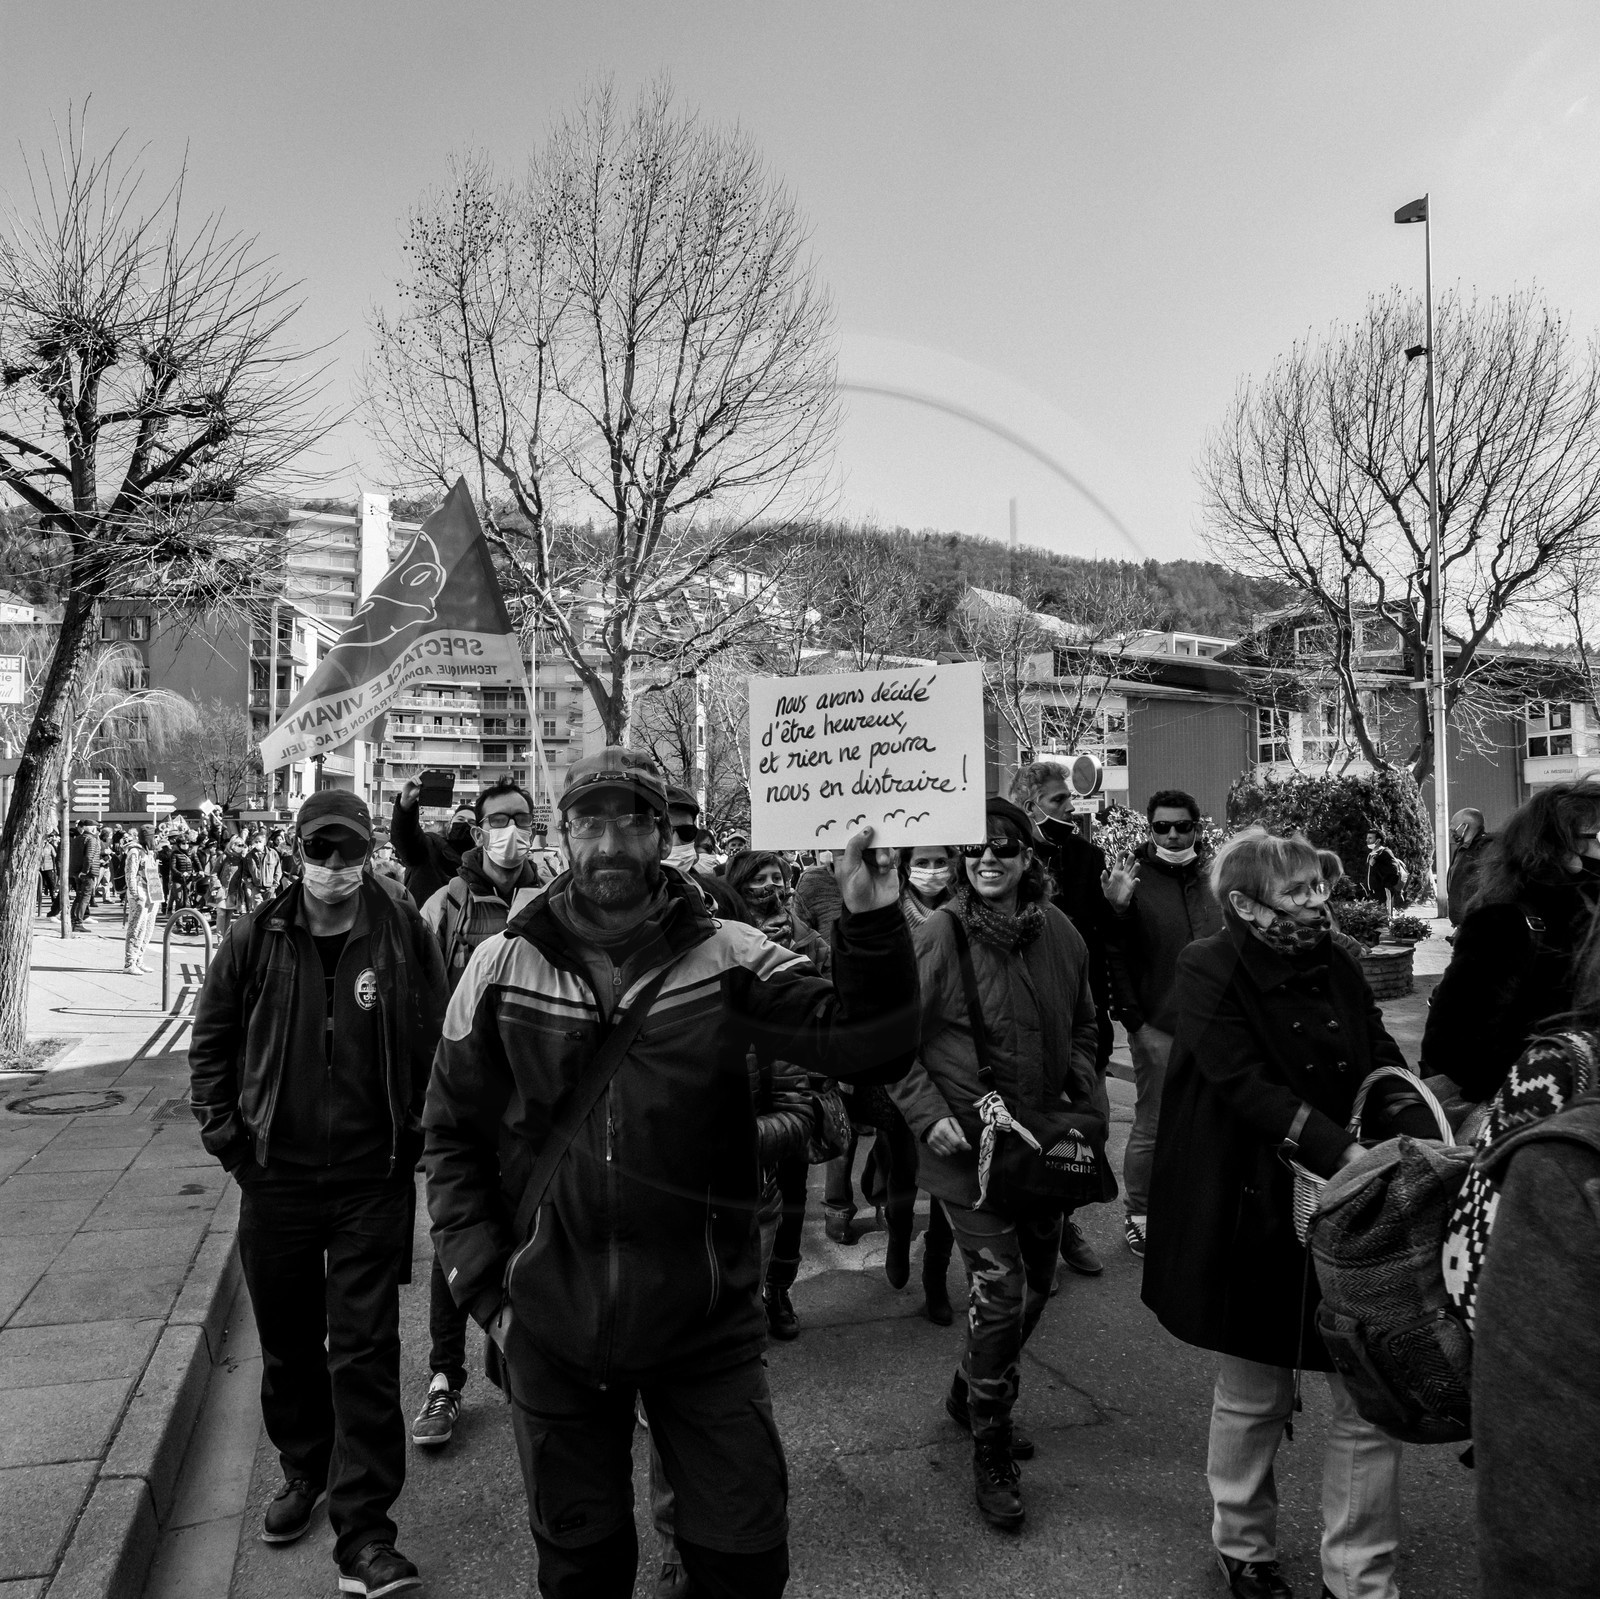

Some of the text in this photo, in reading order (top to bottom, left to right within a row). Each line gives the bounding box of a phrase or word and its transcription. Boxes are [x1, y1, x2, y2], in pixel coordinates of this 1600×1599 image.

[775, 674, 937, 717] nous avons décidé
[761, 710, 908, 747] d'être heureux,
[759, 735, 936, 774] et rien ne pourra
[766, 782, 810, 803] nous
[819, 780, 843, 799] en
[851, 768, 956, 796] distraire
